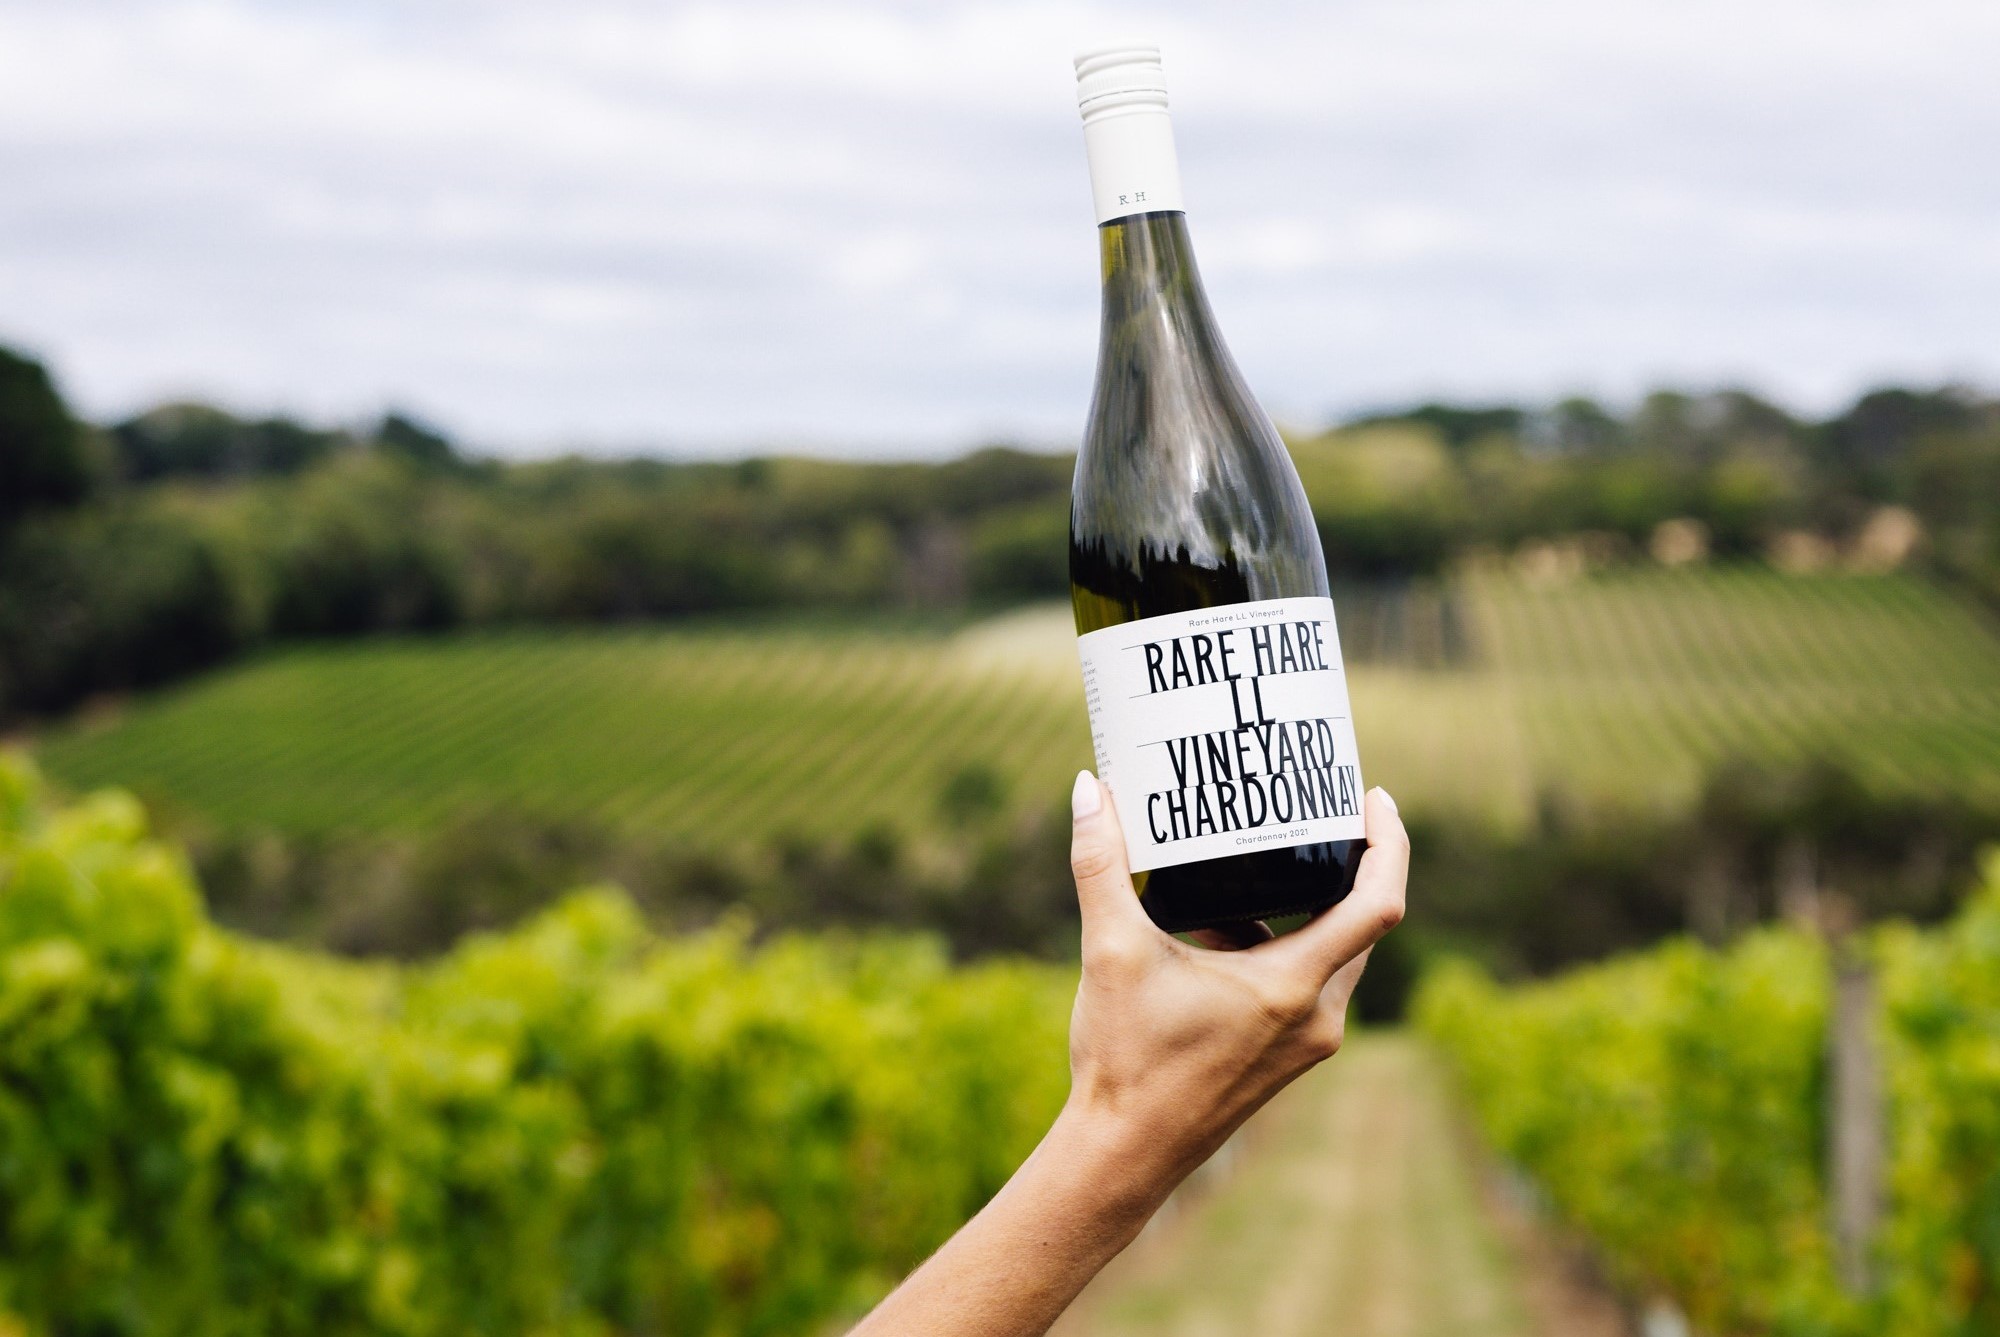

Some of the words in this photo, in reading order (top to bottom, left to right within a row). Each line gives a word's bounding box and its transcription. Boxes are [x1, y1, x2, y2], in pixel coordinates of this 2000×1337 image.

[1118, 194, 1129, 205] R
[1135, 191, 1146, 202] H
[1188, 618, 1210, 628] Rare
[1212, 614, 1233, 624] Hare
[1236, 613, 1247, 621] LL
[1249, 608, 1284, 619] Vineyard
[1144, 630, 1241, 694] RARE
[1250, 620, 1329, 677] HARE
[1229, 676, 1276, 729] LL
[1165, 718, 1335, 790] VINEYARD
[1147, 765, 1359, 844] CHARDONNAY
[1235, 832, 1288, 845] Chardonnay
[1289, 828, 1309, 837] 2021
